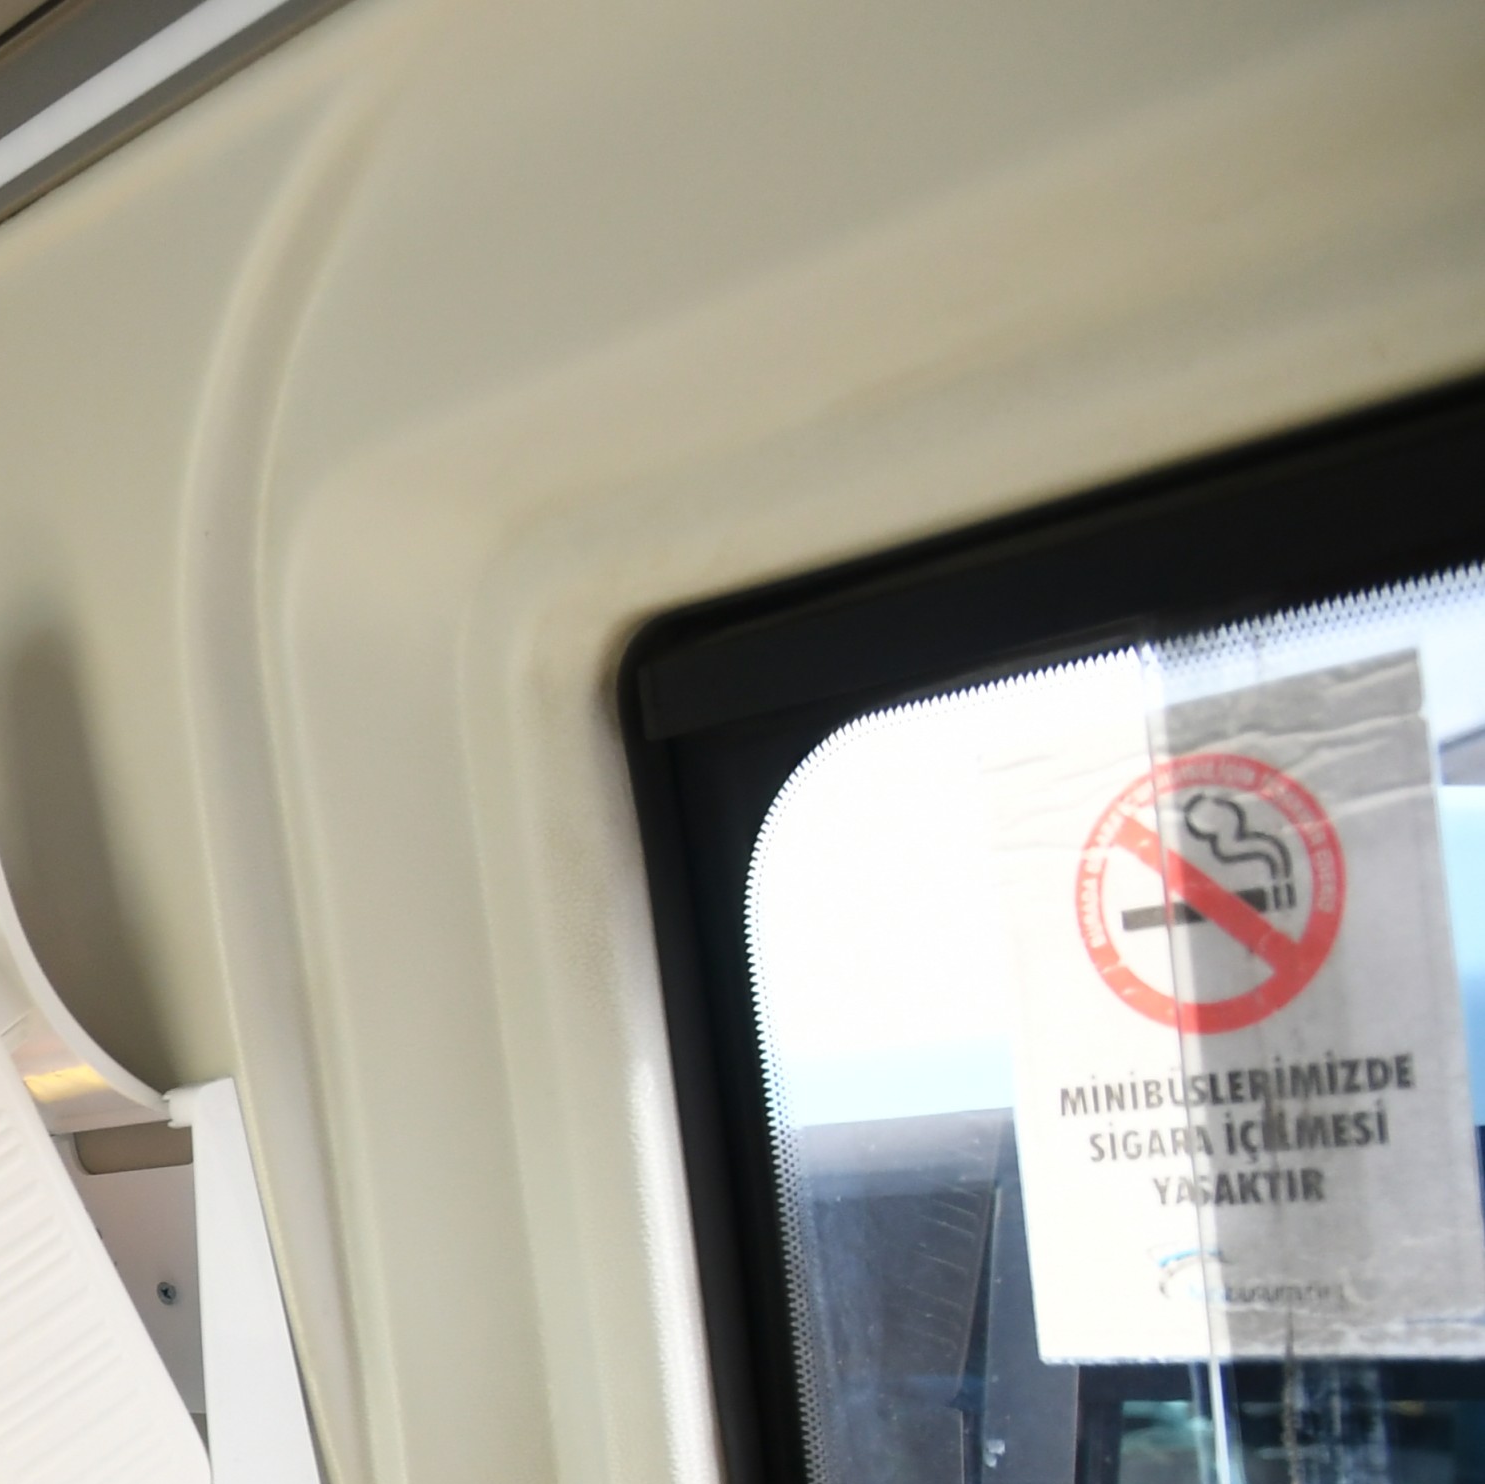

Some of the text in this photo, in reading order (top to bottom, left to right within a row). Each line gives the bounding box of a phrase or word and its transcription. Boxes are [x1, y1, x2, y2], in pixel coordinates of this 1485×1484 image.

[1089, 1097, 1389, 1164] SİGARA İÇİLMESİ
[1153, 1167, 1325, 1206] YASAKTIR
